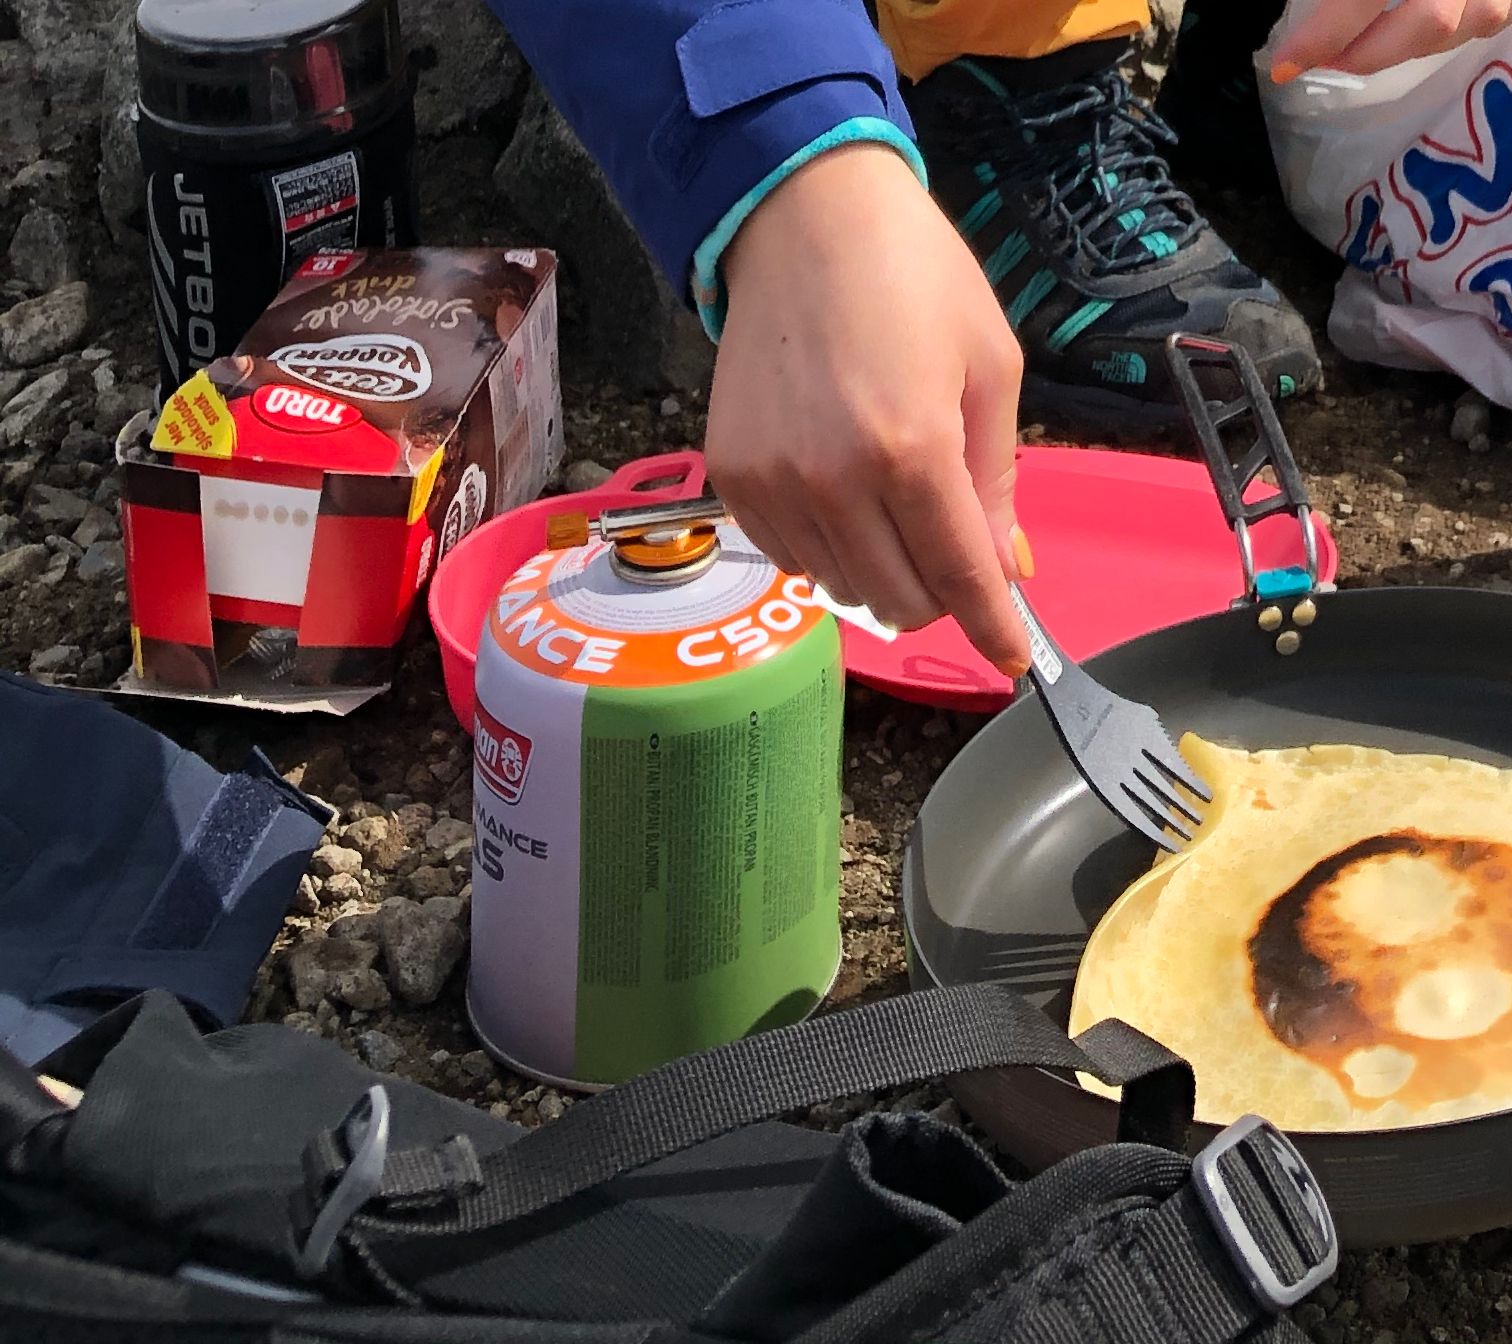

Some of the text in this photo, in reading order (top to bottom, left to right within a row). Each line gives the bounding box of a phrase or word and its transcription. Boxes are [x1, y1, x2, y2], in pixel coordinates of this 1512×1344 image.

[173, 172, 216, 369] JETBOI
[294, 345, 423, 374] Koppen
[319, 368, 404, 396] Rett
[192, 391, 220, 426] smak
[265, 386, 348, 425] TORO
[164, 420, 186, 446] Mer
